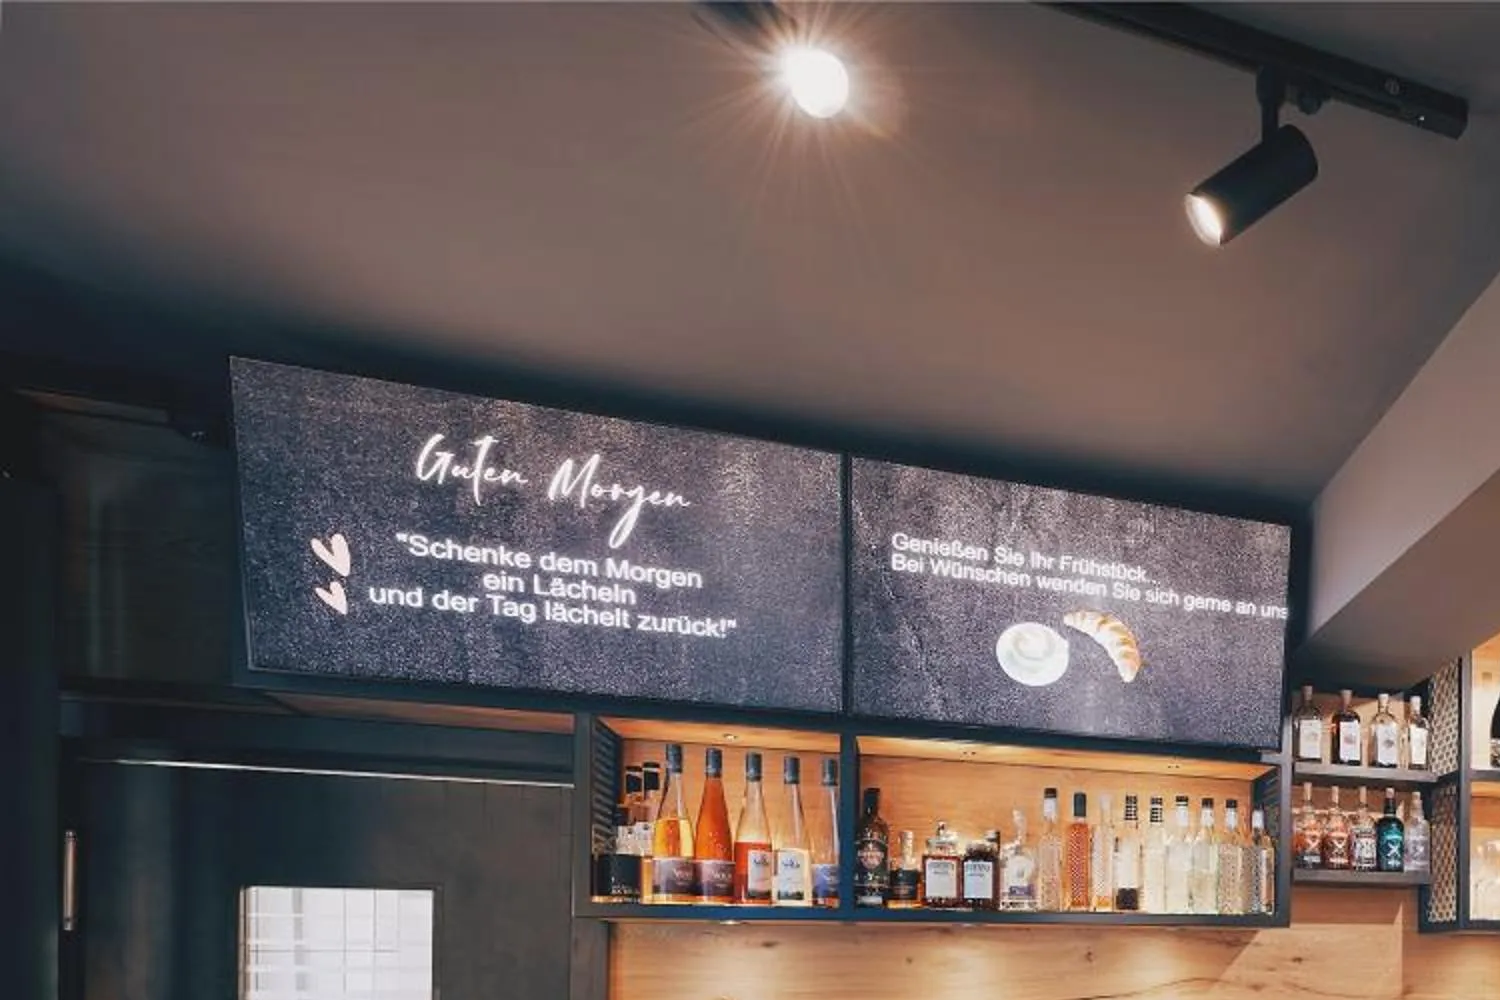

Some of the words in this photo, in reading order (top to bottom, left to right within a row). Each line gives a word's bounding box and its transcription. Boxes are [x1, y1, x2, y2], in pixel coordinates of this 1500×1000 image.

[415, 433, 529, 507] Guten
[548, 453, 692, 549] Morgen
[539, 551, 598, 577] dem
[605, 557, 703, 589] Morgen
[891, 532, 989, 562] Genießen
[993, 546, 1025, 567] Sie
[1030, 550, 1055, 571] Ihr
[483, 570, 525, 593] ein
[533, 573, 636, 605] Lächeln
[891, 553, 924, 573] Bei
[929, 557, 1031, 588] Wünschen
[1036, 575, 1107, 598] wenden
[1112, 581, 1141, 601] Sie
[1145, 585, 1179, 606] sich
[1183, 594, 1232, 612] gerne
[1235, 601, 1256, 616] an
[368, 586, 423, 608] und
[431, 589, 478, 613] der
[486, 593, 537, 624] Tag
[545, 600, 631, 629] lächelt
